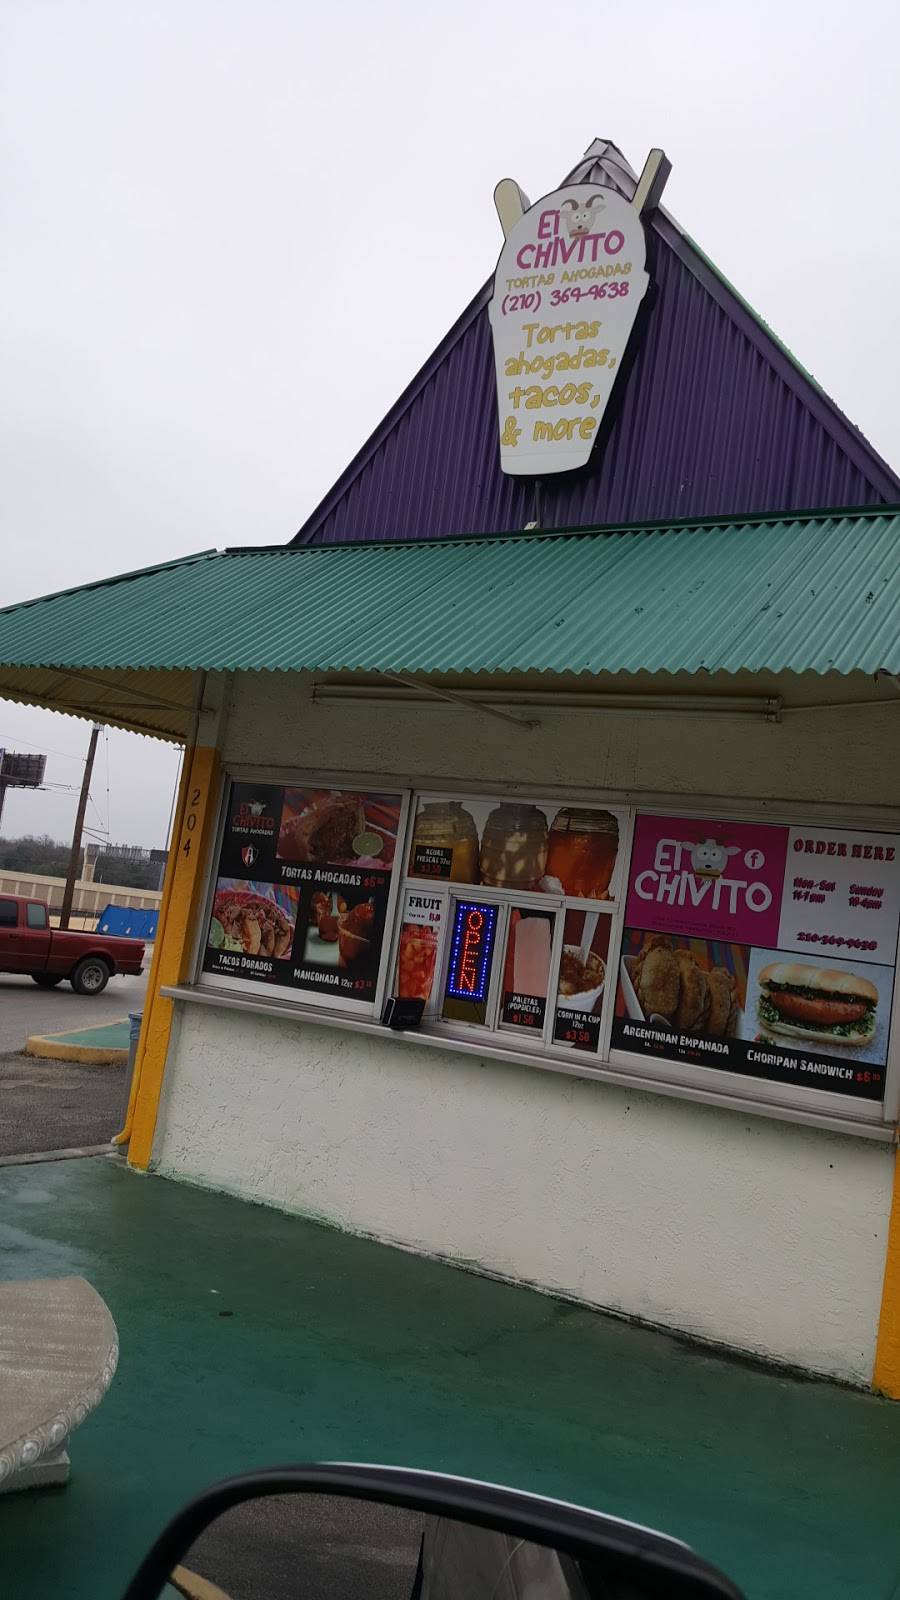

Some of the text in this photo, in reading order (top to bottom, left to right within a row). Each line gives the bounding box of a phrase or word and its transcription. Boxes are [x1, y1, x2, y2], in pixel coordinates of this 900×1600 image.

[516, 229, 625, 270] CHIVITO
[506, 261, 633, 291] TORTAS AHOGADAS
[501, 290, 541, 316] (210)
[521, 320, 602, 348] Tortas
[504, 345, 616, 380] ahogadas,
[509, 382, 600, 410] tacos,
[501, 415, 597, 447] & more
[231, 815, 275, 829] CHIVITO
[793, 838, 896, 861] ORDER HERE
[281, 866, 313, 880] TORTAS
[314, 869, 362, 886] AHOGADAS
[409, 896, 442, 910] FRUIT
[634, 869, 773, 914] CHIVITO
[848, 884, 884, 898] Sunday
[218, 954, 240, 967] TACOS
[240, 956, 273, 973] DORADOS
[459, 911, 483, 993] OPEN
[293, 968, 340, 986] MANGONADA
[508, 1003, 542, 1015] (POPSICLES)
[512, 996, 538, 1006] PALETAS
[557, 1010, 574, 1020] CORN
[582, 1014, 588, 1022] A
[588, 1015, 601, 1024] CUP
[622, 1024, 679, 1045] ARGENTINIAN
[679, 1035, 730, 1055] EMPANADA
[746, 1049, 798, 1070] CHORIPAN
[799, 1059, 854, 1080] SANDWICH
